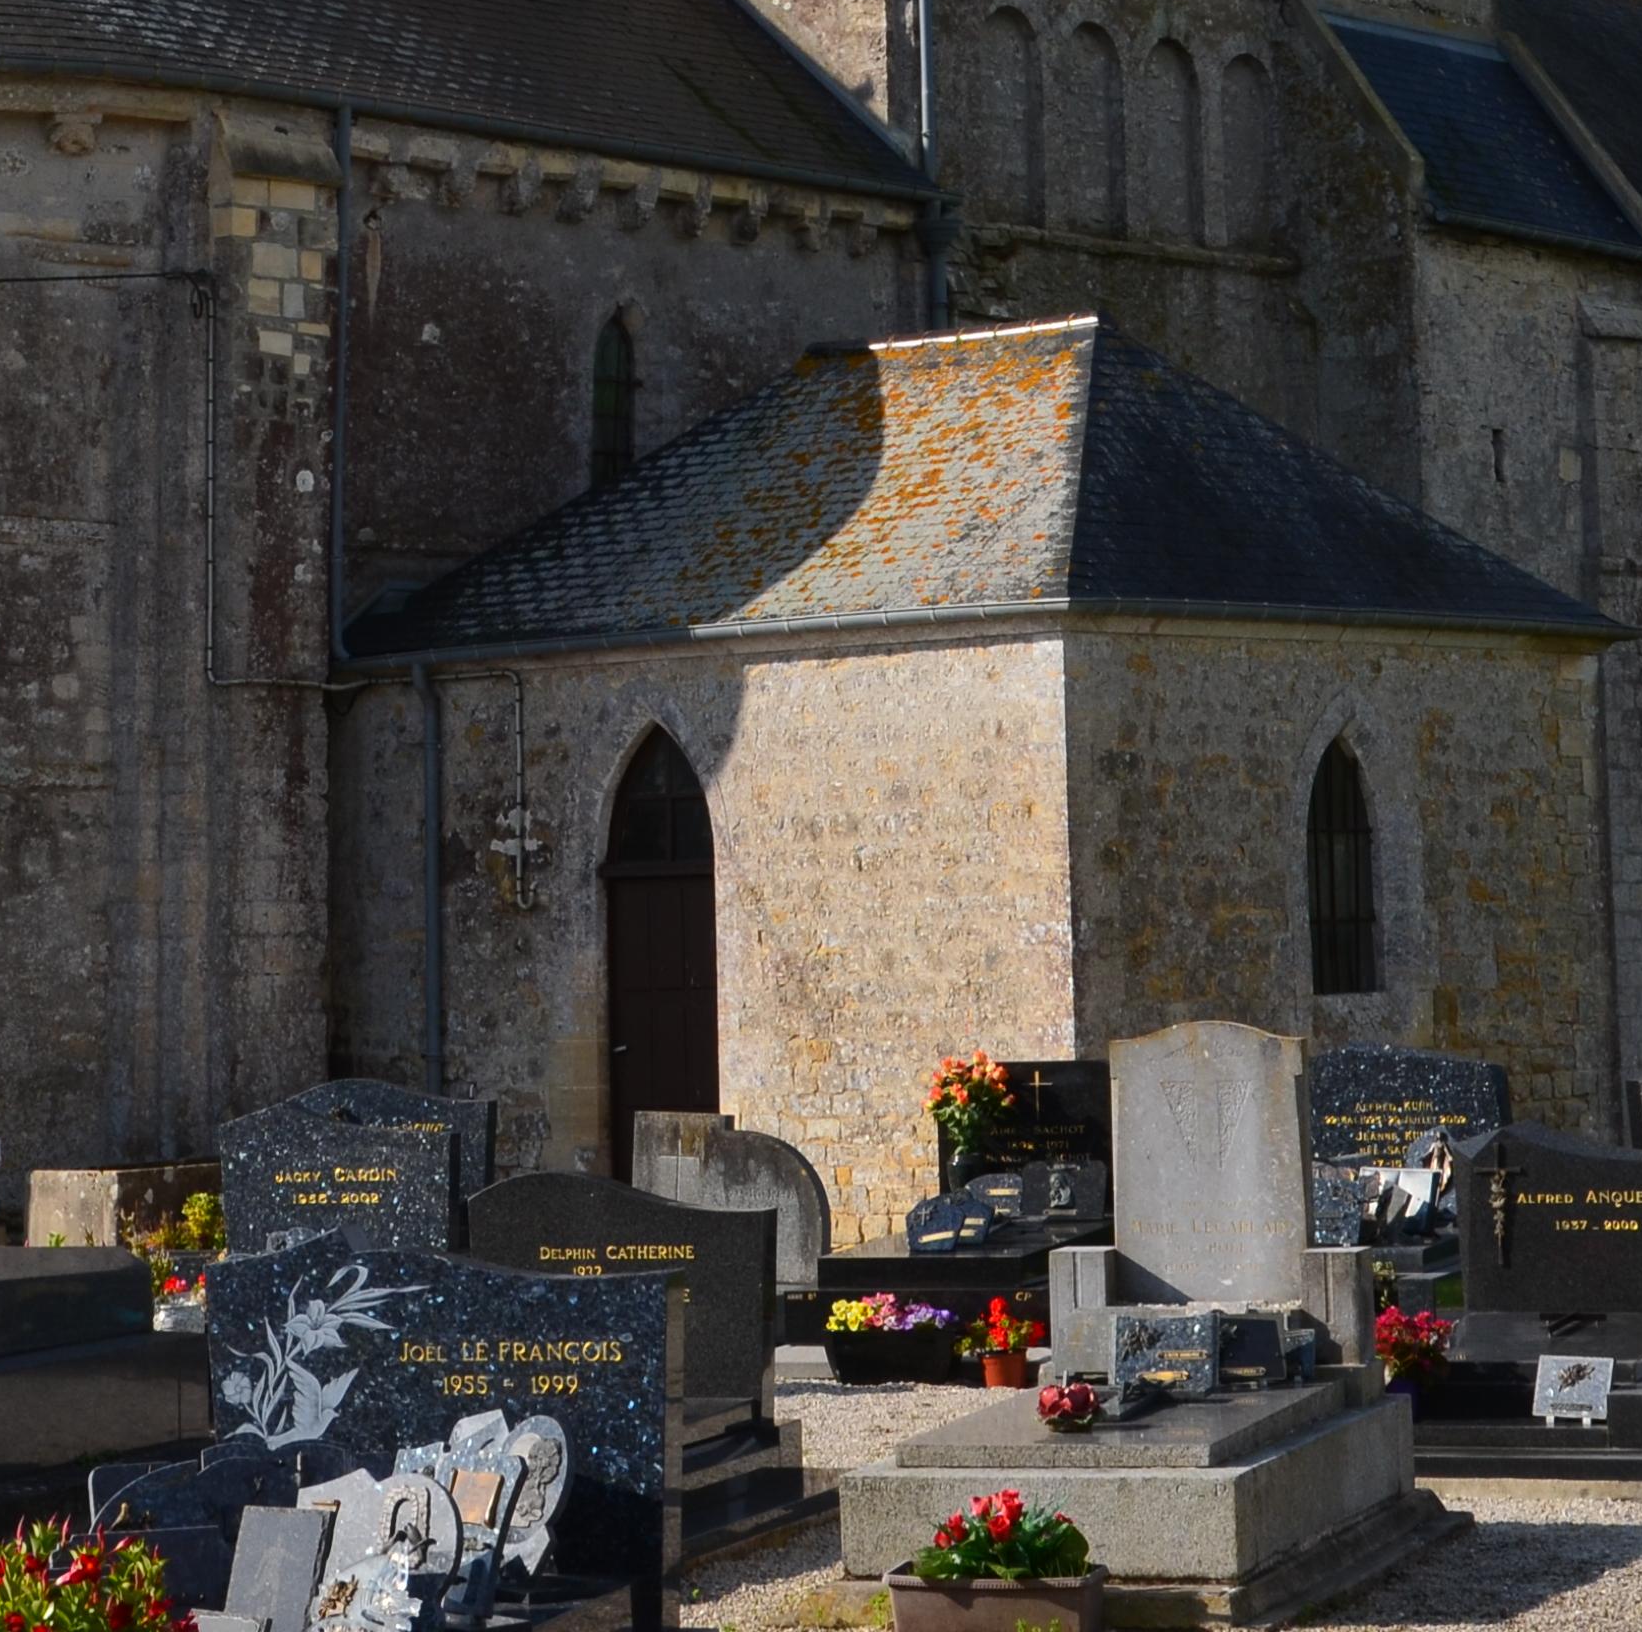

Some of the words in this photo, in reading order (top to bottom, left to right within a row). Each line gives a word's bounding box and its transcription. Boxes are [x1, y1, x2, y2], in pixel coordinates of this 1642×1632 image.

[274, 1170, 321, 1183] JACKY
[333, 1167, 398, 1183] CARDIN
[1516, 1193, 1574, 1205] ALFRED
[539, 1246, 596, 1261] DELPHIN
[606, 1244, 695, 1260] CATHERINE
[497, 1340, 623, 1366] FRANÇOIS
[443, 1375, 489, 1396] 1955
[530, 1375, 579, 1396] 1999
